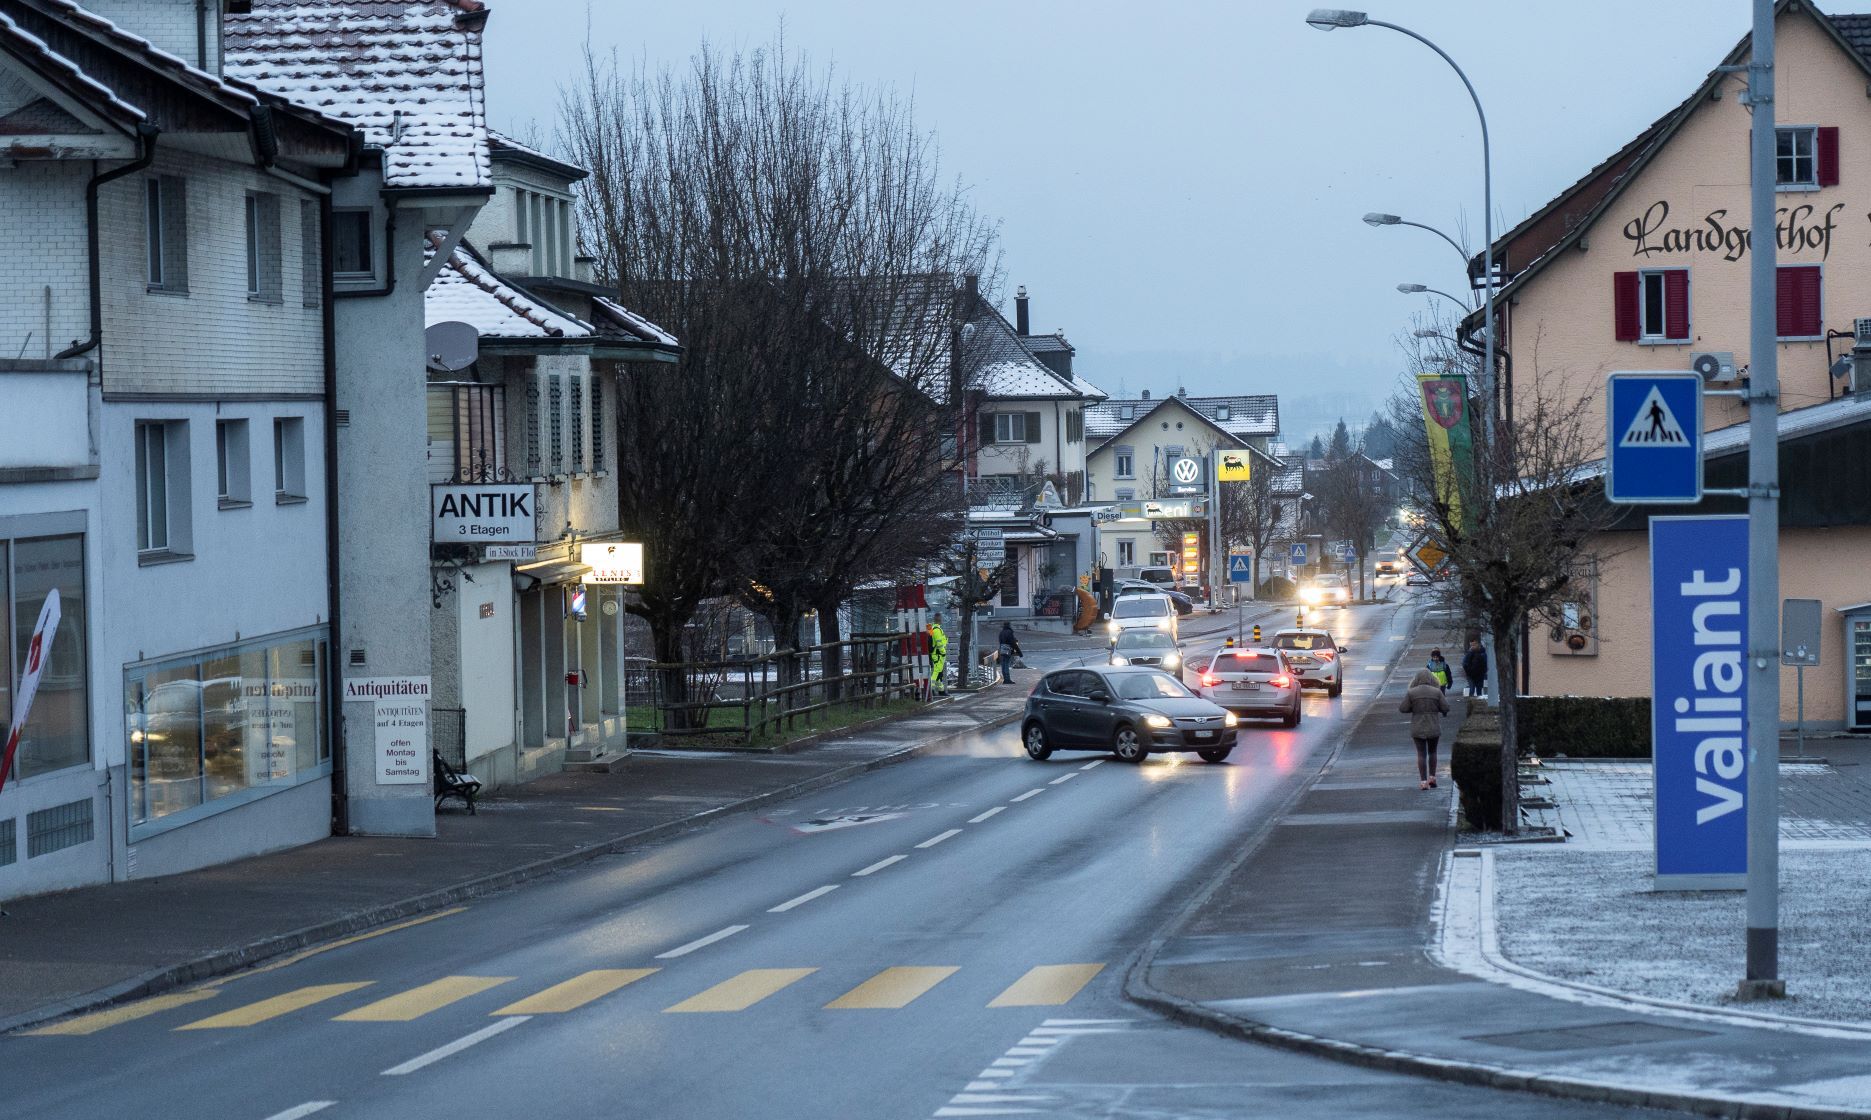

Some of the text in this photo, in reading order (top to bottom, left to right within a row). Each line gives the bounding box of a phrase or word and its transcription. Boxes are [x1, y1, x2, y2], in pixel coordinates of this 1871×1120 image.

[1622, 199, 1846, 263] Landgthof
[438, 492, 531, 518] ANTIK
[1097, 511, 1122, 520] Diesel
[458, 524, 510, 537] 3 Etagen
[489, 547, 497, 558] in
[346, 680, 428, 698] Antiquitäten
[1674, 567, 1744, 826] valiant
[376, 706, 424, 718] ANTIQUITÄTEN
[398, 720, 424, 728] Etagen
[386, 749, 416, 757] Montag
